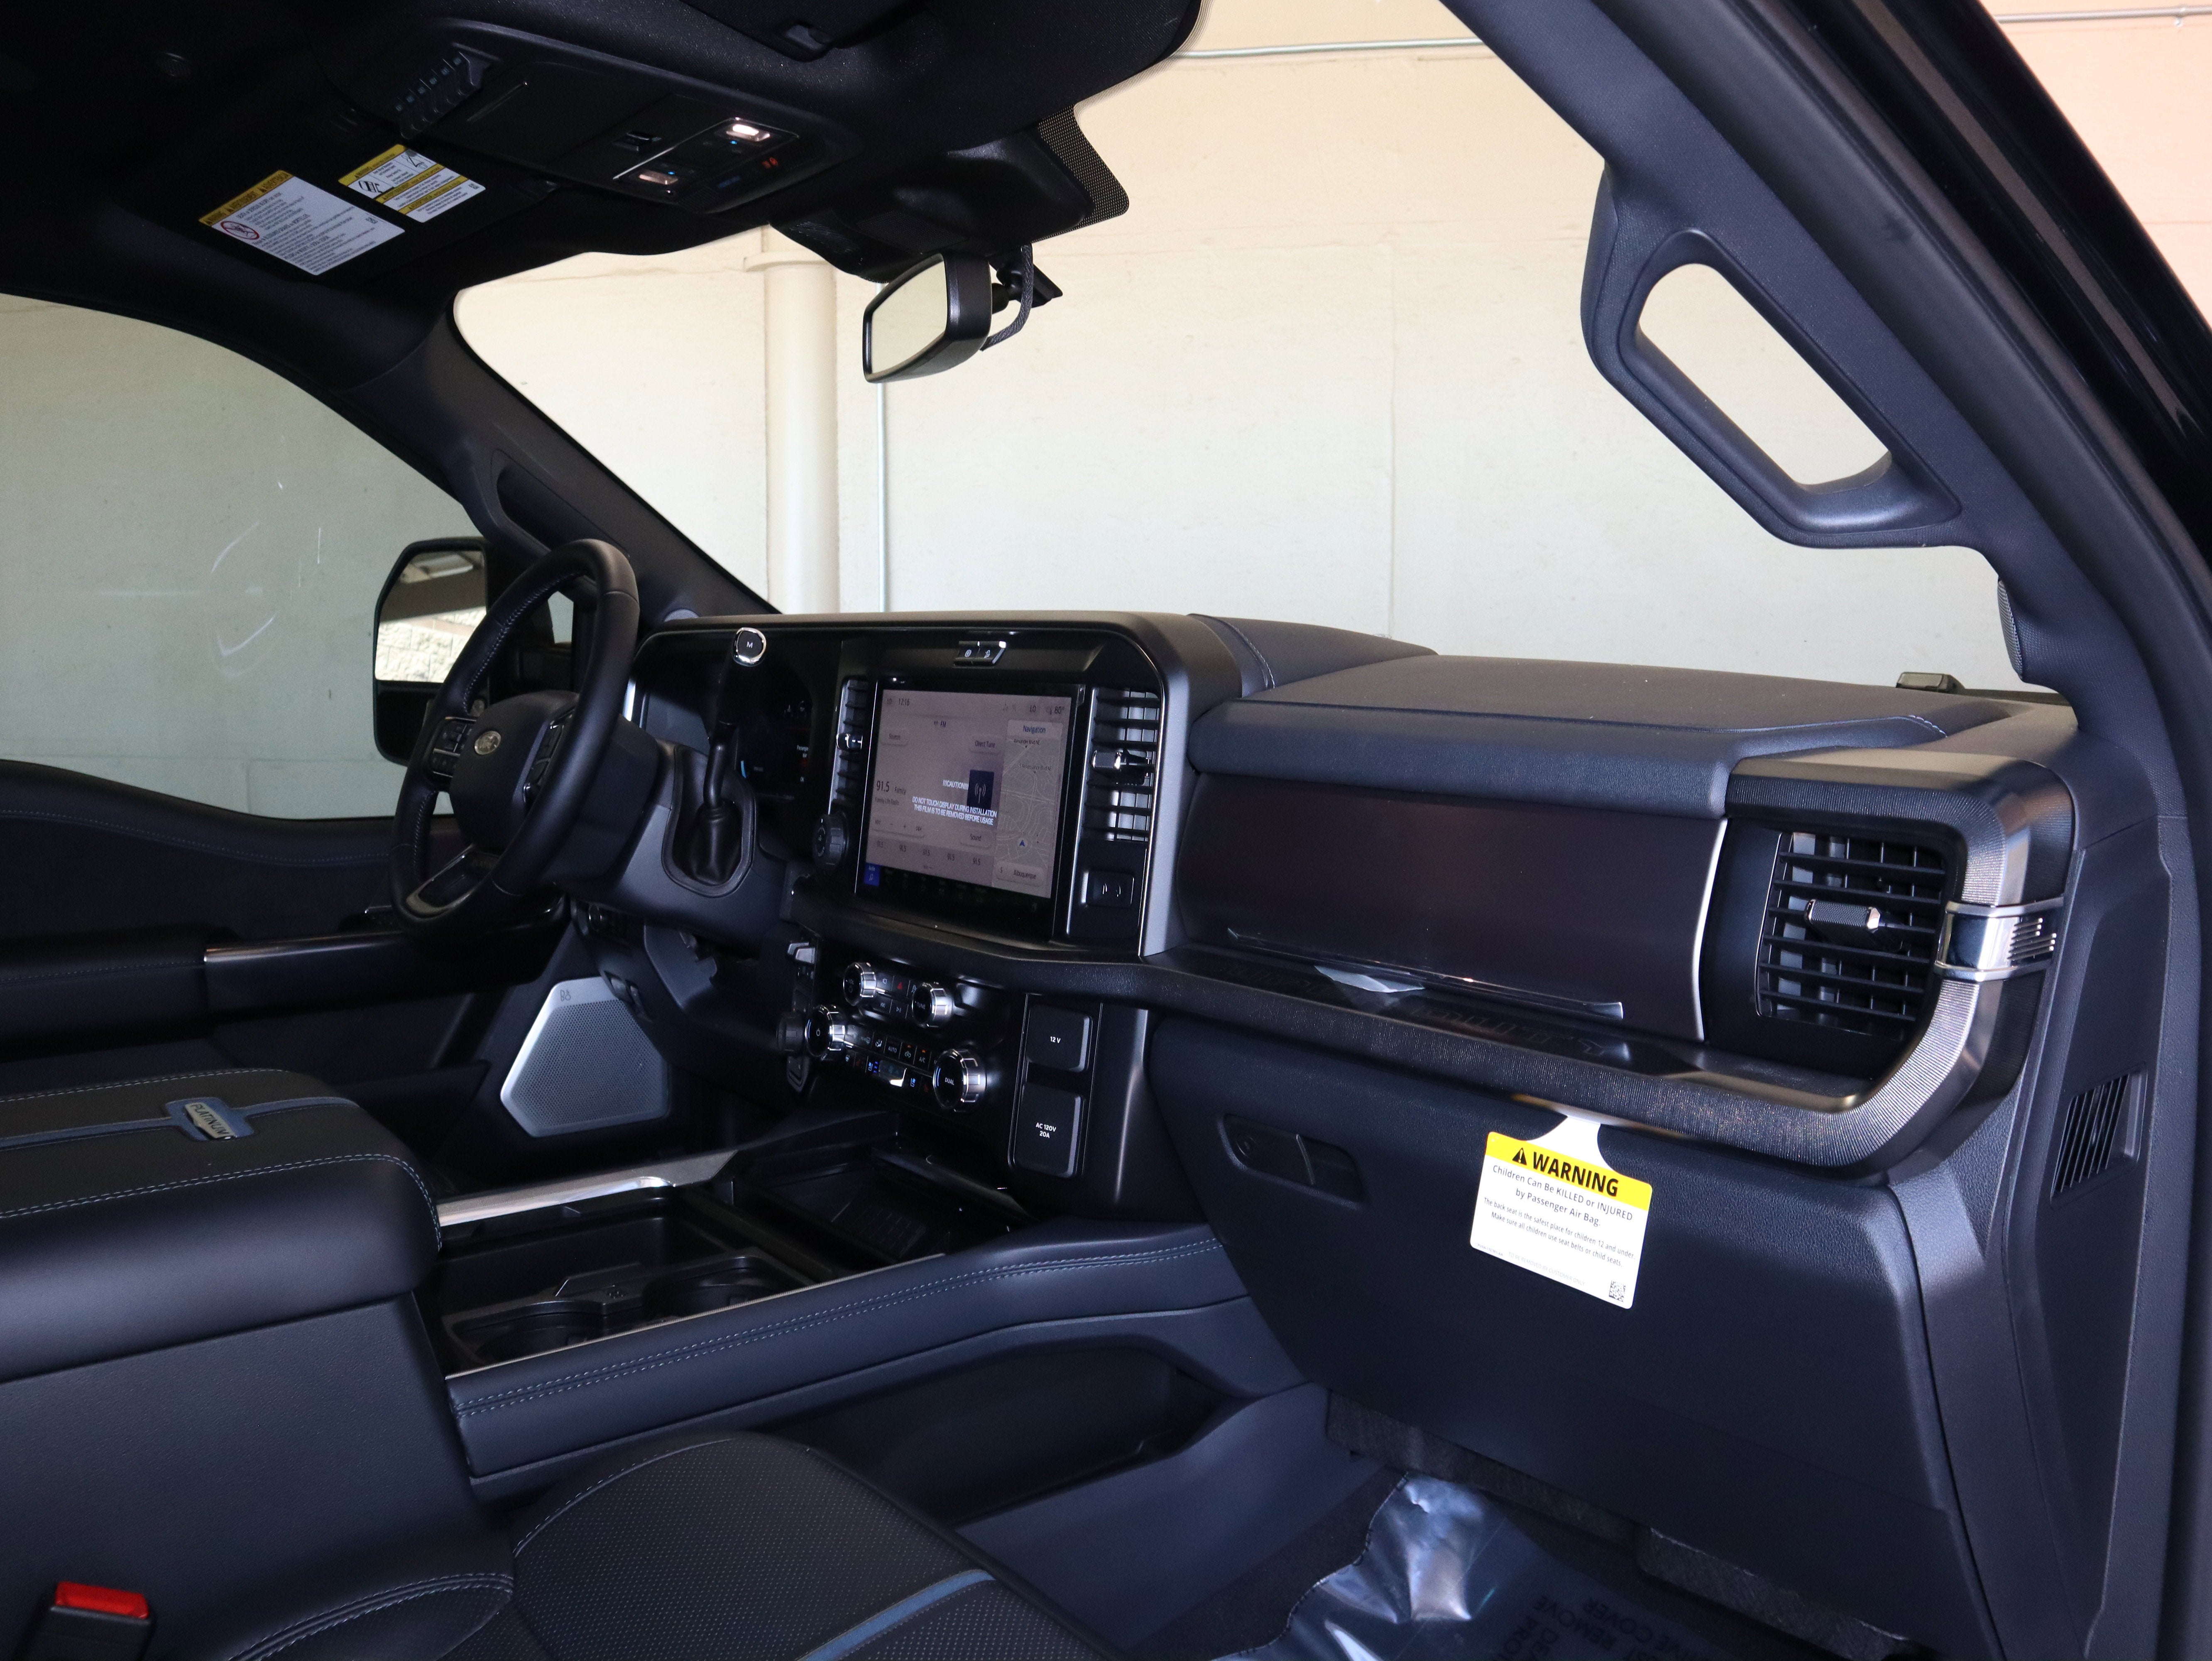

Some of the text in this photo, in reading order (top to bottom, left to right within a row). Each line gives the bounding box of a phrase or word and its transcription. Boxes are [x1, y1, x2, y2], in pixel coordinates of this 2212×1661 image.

[1023, 725, 1046, 734] Navigation
[876, 781, 890, 792] 91.5
[922, 805, 931, 814] FILM
[946, 810, 964, 820] REMOVED
[964, 813, 980, 823] BEFORE
[980, 816, 994, 826] USAGE
[926, 799, 939, 807] TOUCH
[939, 801, 955, 810] DISPLAY
[955, 803, 969, 813] DURING
[969, 806, 997, 818] INSTALLATION
[1014, 870, 1036, 880] Albuquerque
[945, 1077, 954, 1085] DUAL
[190, 1104, 229, 1134] PLATINUM
[1044, 1124, 1057, 1132] 120V
[1039, 1131, 1050, 1139] 20A
[1533, 1152, 1618, 1196] WARNING
[1493, 1165, 1524, 1182] Children
[1527, 1177, 1542, 1188] Can
[1544, 1183, 1554, 1193] Be
[1556, 1187, 1583, 1203] KILLED
[1597, 1202, 1632, 1220] INJURED
[1516, 1188, 1600, 1227] by Passenger Air Bag.
[1491, 1211, 1505, 1222] Make
[1526, 1225, 1546, 1237] children
[1571, 1241, 1583, 1252] belts
[1593, 1250, 1605, 1260] child
[1607, 1257, 1622, 1267] seats.
[1494, 1200, 1505, 1210] back
[1534, 1217, 1549, 1227] safest
[1550, 1223, 1564, 1232] place
[1574, 1232, 1595, 1244] children
[1617, 1249, 1635, 1259] under.
[1521, 1257, 1542, 1269] REMOVED
[1548, 1268, 1573, 1281] CUSTOMER
[1573, 1277, 1586, 1286] ONLY
[1581, 1597, 1654, 1644] COVER
